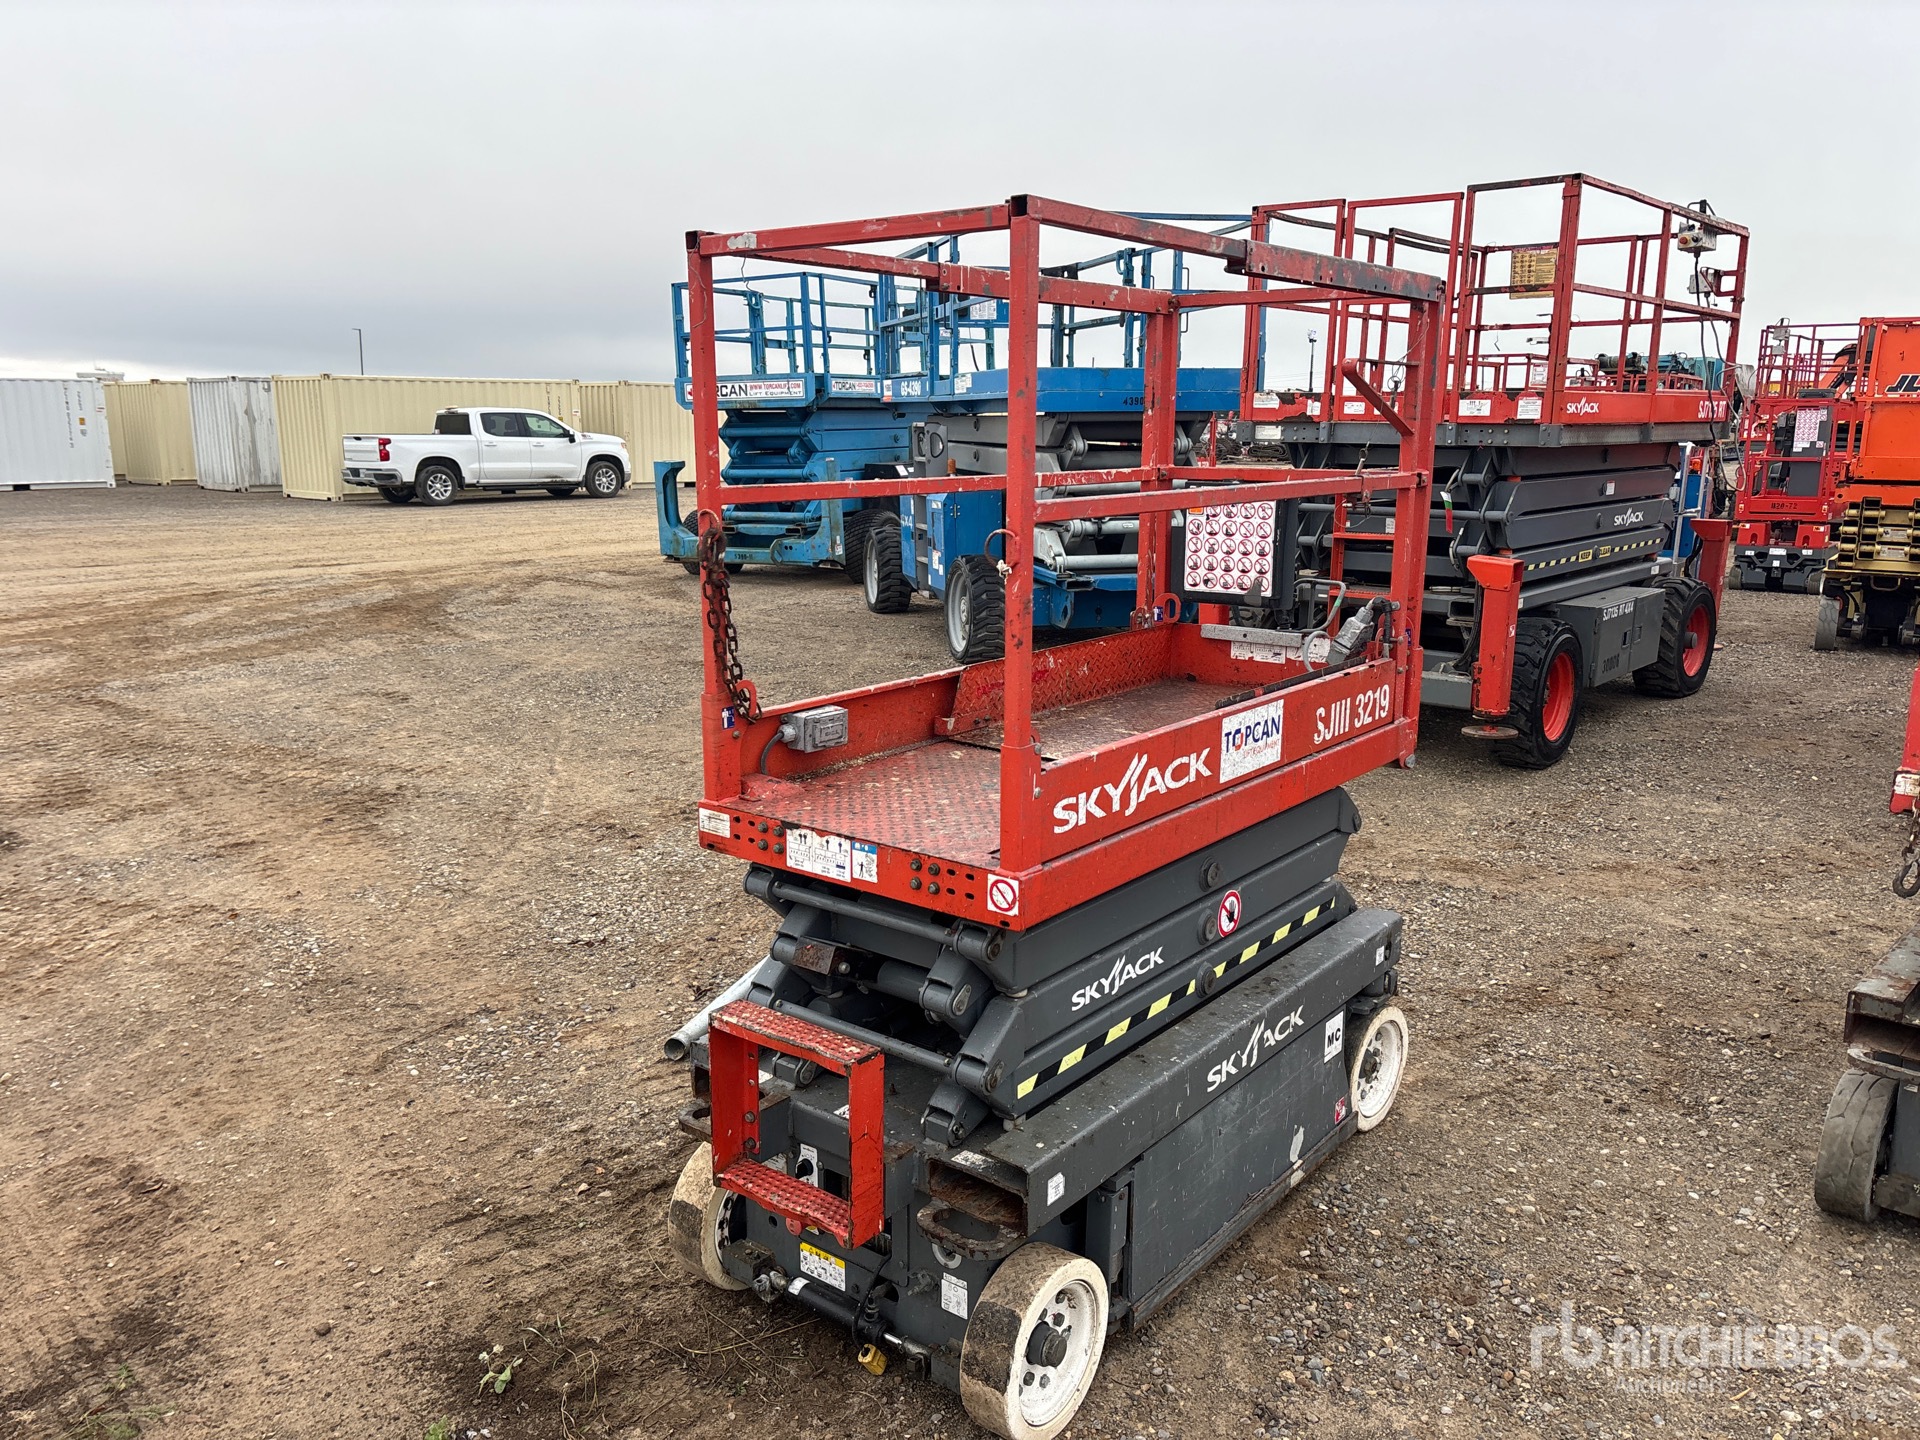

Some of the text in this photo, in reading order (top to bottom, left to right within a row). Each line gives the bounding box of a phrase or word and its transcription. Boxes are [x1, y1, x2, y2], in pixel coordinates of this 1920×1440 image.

[716, 384, 748, 398] CAN
[835, 382, 856, 391] TORCAN
[900, 381, 921, 397] GS-4390
[1566, 396, 1599, 416] SKYJACK
[1613, 507, 1644, 527] SKYJACK
[1354, 684, 1390, 729] 3219
[1052, 747, 1213, 835] SKYJACK
[1071, 946, 1165, 1012] SKYJACK
[1327, 1027, 1341, 1049] MC
[1206, 1005, 1305, 1093] SKYJACK
